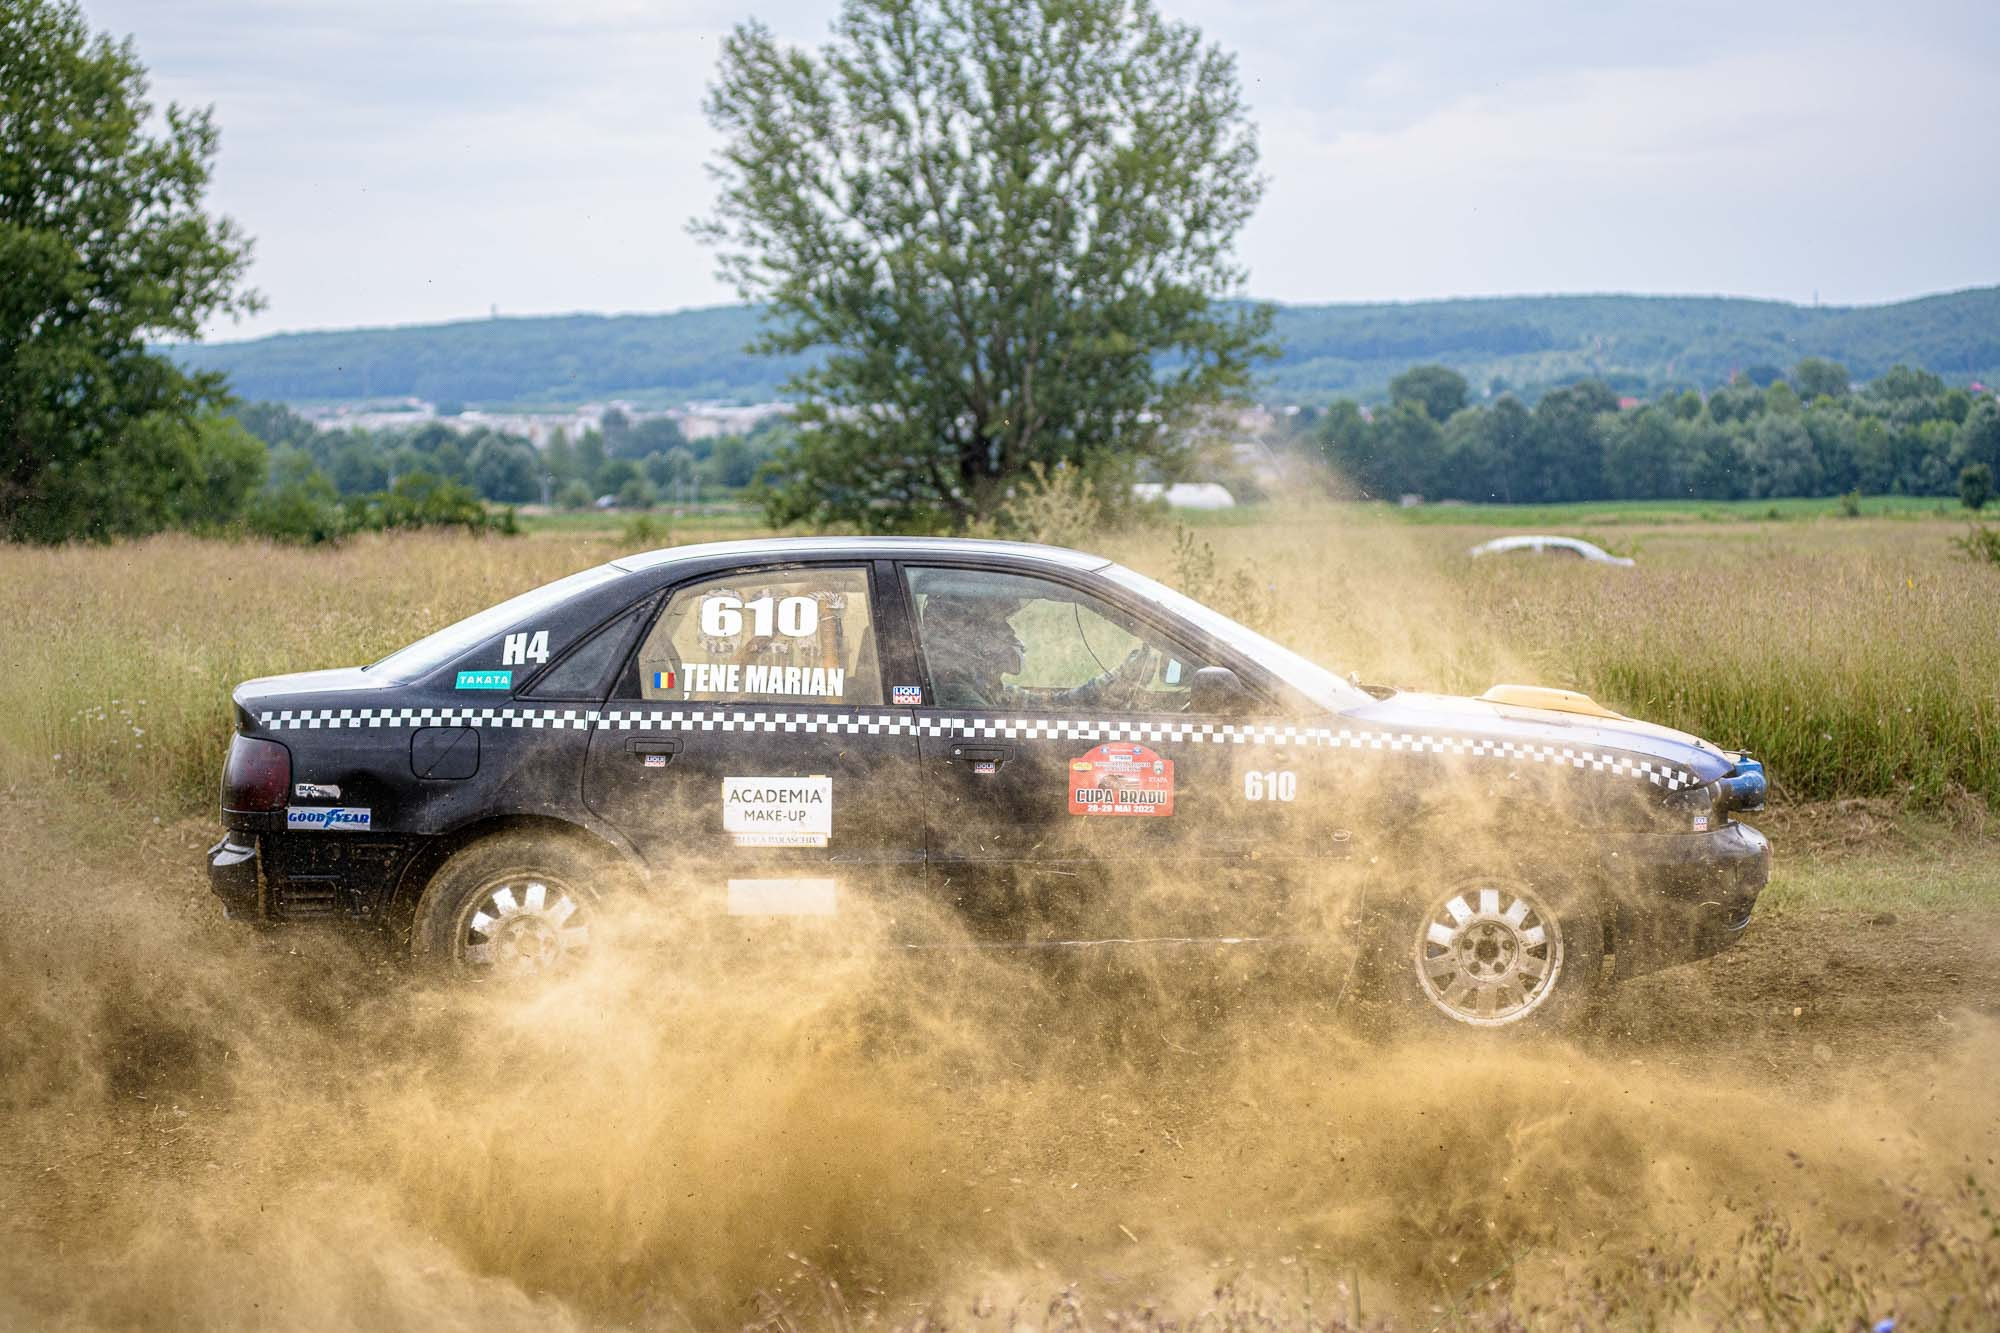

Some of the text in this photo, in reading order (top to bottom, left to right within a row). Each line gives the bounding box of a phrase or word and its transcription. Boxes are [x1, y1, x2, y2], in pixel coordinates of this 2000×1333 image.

[701, 596, 818, 638] 610
[502, 630, 550, 666] H4
[460, 675, 509, 684] TAKATA
[745, 665, 844, 697] MARIAN
[894, 687, 920, 696] LIQUI
[893, 696, 920, 704] MOLY
[1244, 770, 1297, 802] 610
[729, 789, 823, 804] ACADEMIA
[1076, 788, 1167, 805] CUPA BRADU
[1114, 804, 1132, 813] MAI
[1133, 805, 1155, 813] 2022
[288, 812, 370, 824] GOODYEAR
[744, 810, 807, 822] MAKE-UP
